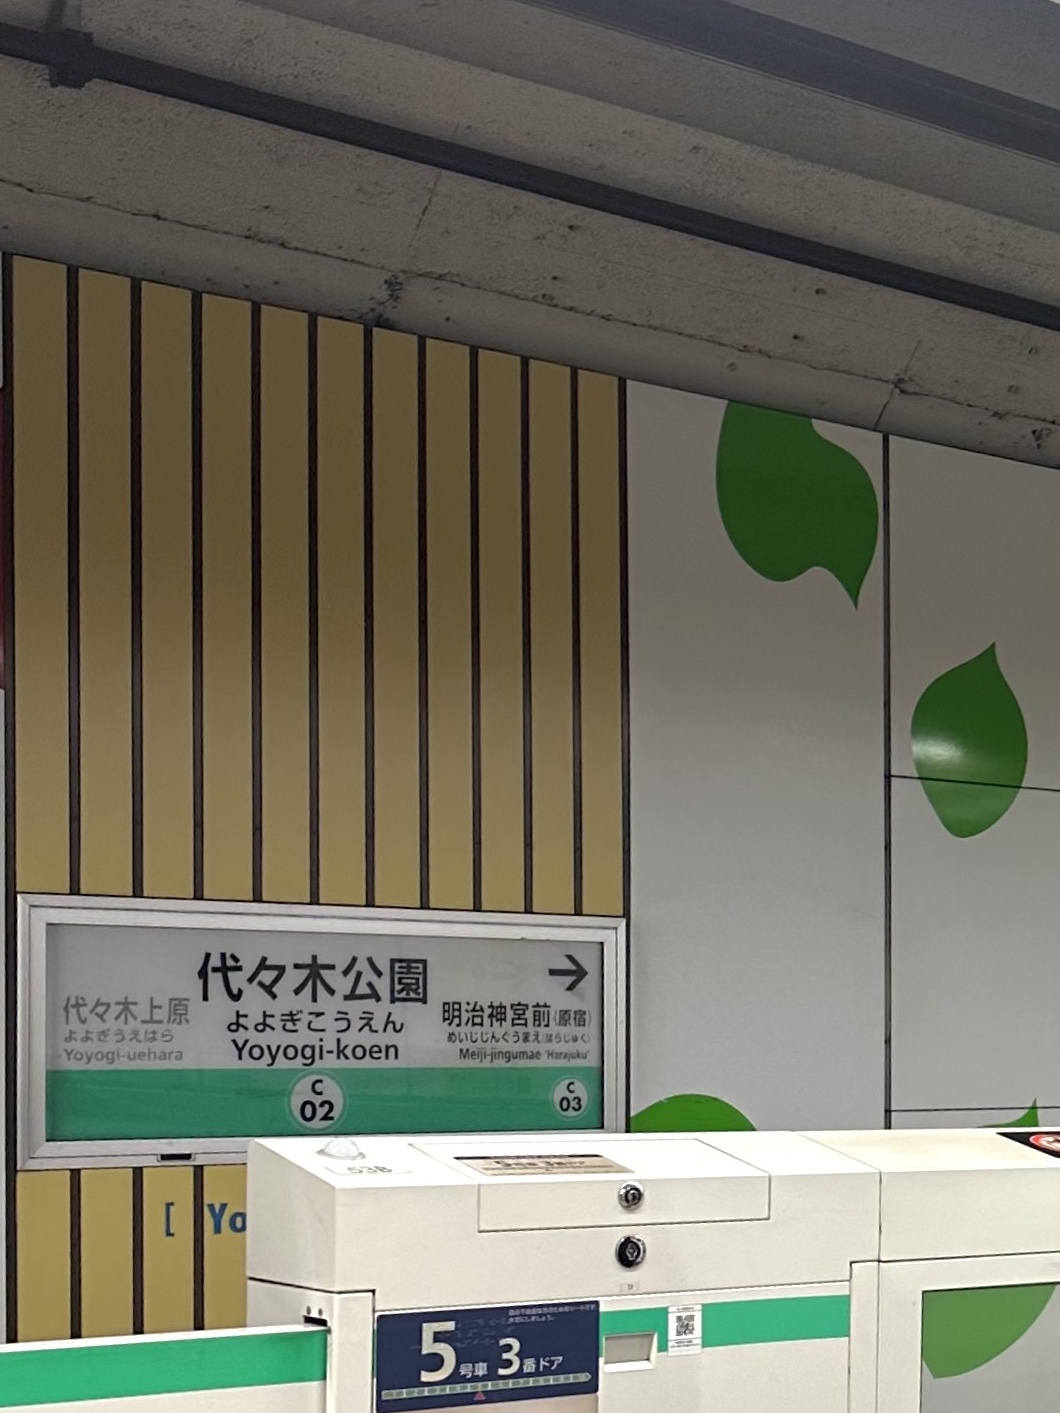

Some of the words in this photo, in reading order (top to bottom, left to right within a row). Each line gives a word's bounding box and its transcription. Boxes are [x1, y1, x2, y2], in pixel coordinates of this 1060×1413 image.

[198, 951, 428, 1005] 代々木公園
[63, 996, 190, 1025] 代々木上原
[227, 1010, 404, 1033] よよぎこうえん
[64, 1029, 174, 1043] よよぎうえはら
[64, 1049, 183, 1064] Yoyogi-uehara
[232, 1038, 399, 1067] Yoyogi-koen
[459, 1048, 541, 1063] Meiji-jingumae
[311, 1080, 323, 1096] C
[566, 1082, 575, 1094] C
[300, 1100, 335, 1122] 02
[559, 1096, 582, 1113] 03
